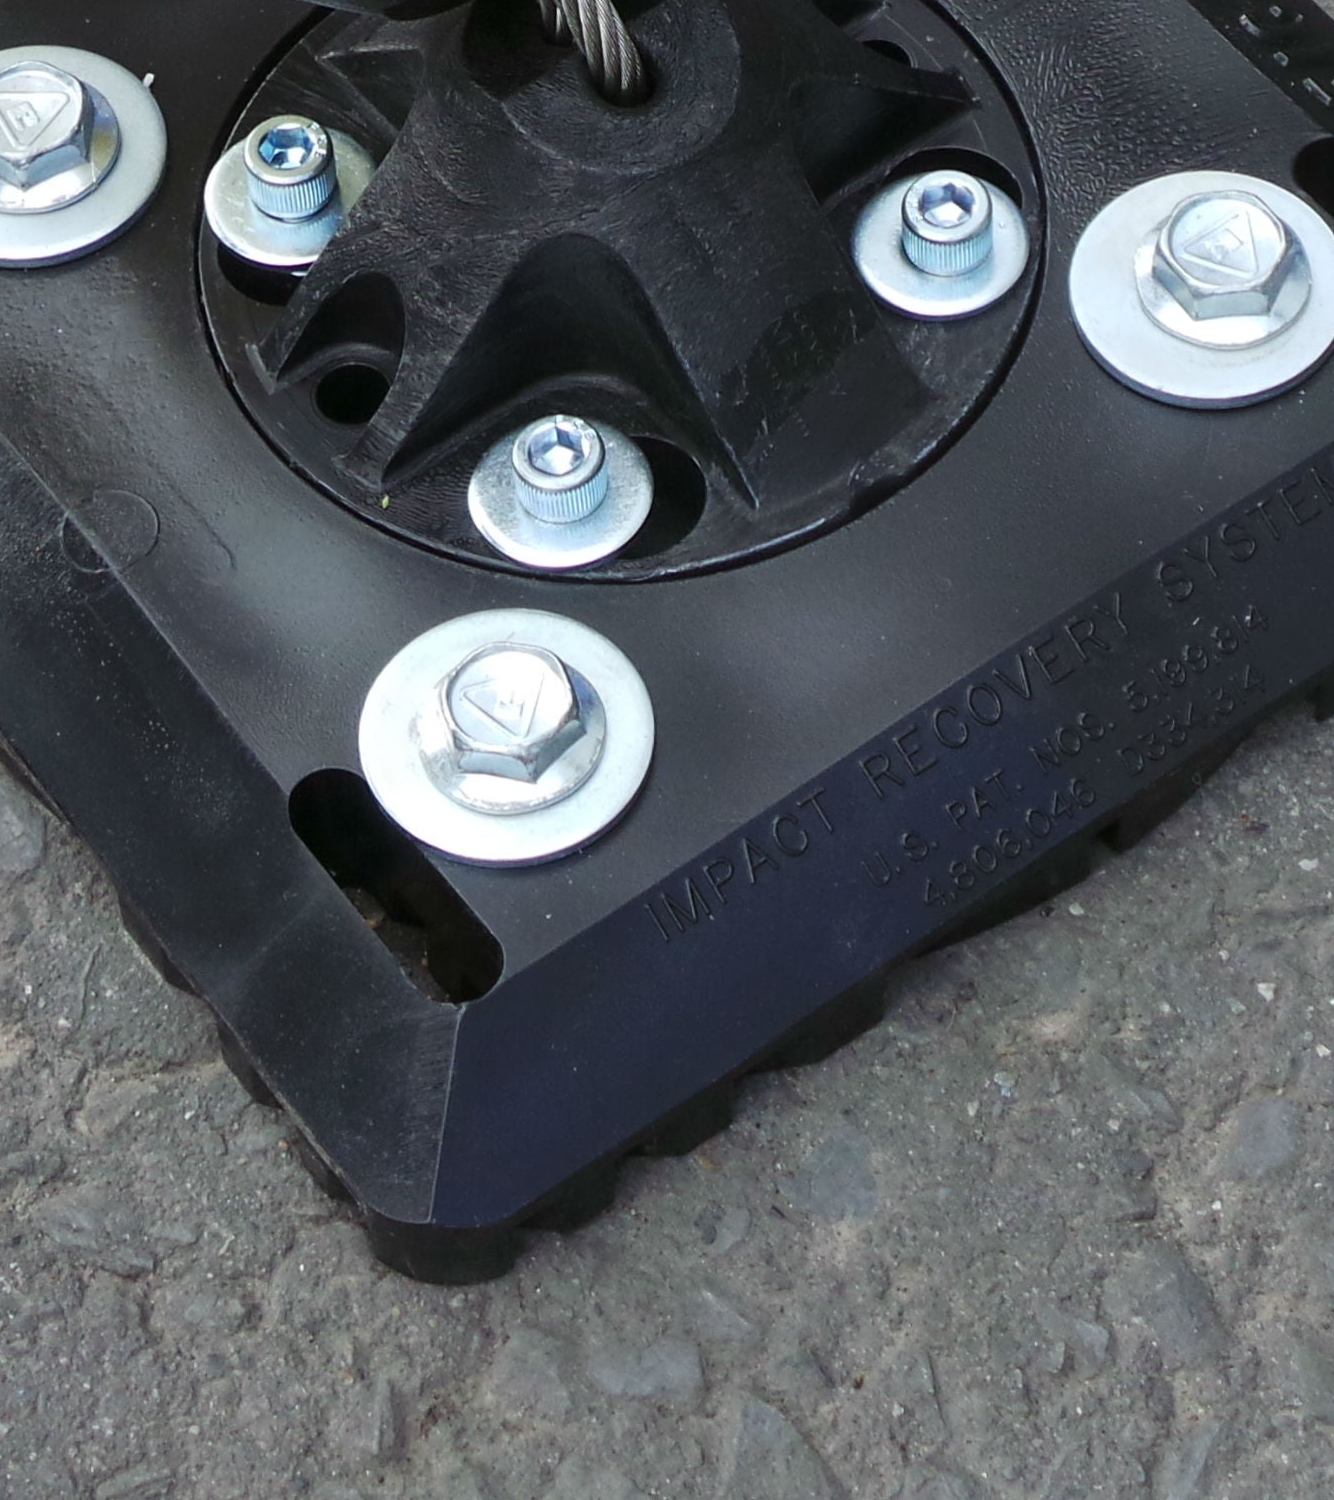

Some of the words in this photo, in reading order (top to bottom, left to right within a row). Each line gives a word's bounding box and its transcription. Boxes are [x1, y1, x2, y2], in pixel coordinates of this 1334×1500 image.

[645, 787, 835, 941] IMPACT
[859, 592, 1130, 799] RECOVERY
[945, 768, 1024, 830] PAT.
[1030, 712, 1115, 774] NOS.
